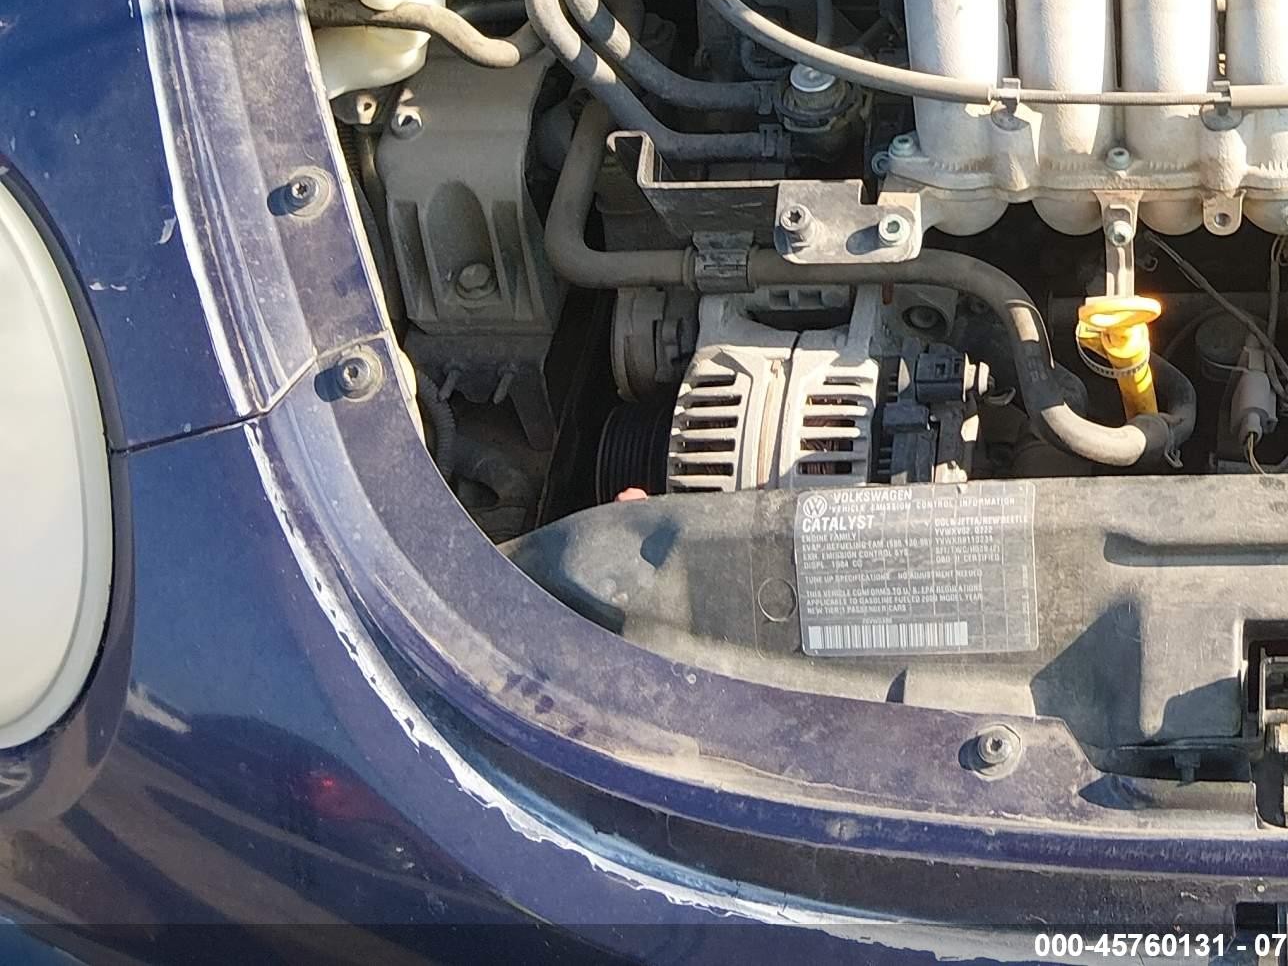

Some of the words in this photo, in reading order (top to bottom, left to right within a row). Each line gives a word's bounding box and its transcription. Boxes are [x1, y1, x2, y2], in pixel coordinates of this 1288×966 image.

[833, 489, 912, 503] VOLKSWAGEN
[831, 504, 865, 513] VEHICLE
[871, 502, 911, 511] EMISSION
[916, 499, 953, 508] CONTROL
[960, 497, 1015, 507] INFORMATION
[802, 515, 874, 532] CATALYST
[801, 534, 827, 543] ENGINE
[830, 532, 857, 541] FAMILY
[859, 549, 892, 559] CONTROL
[805, 575, 822, 584] TUNE
[824, 575, 834, 583] UP
[898, 572, 908, 580] NO
